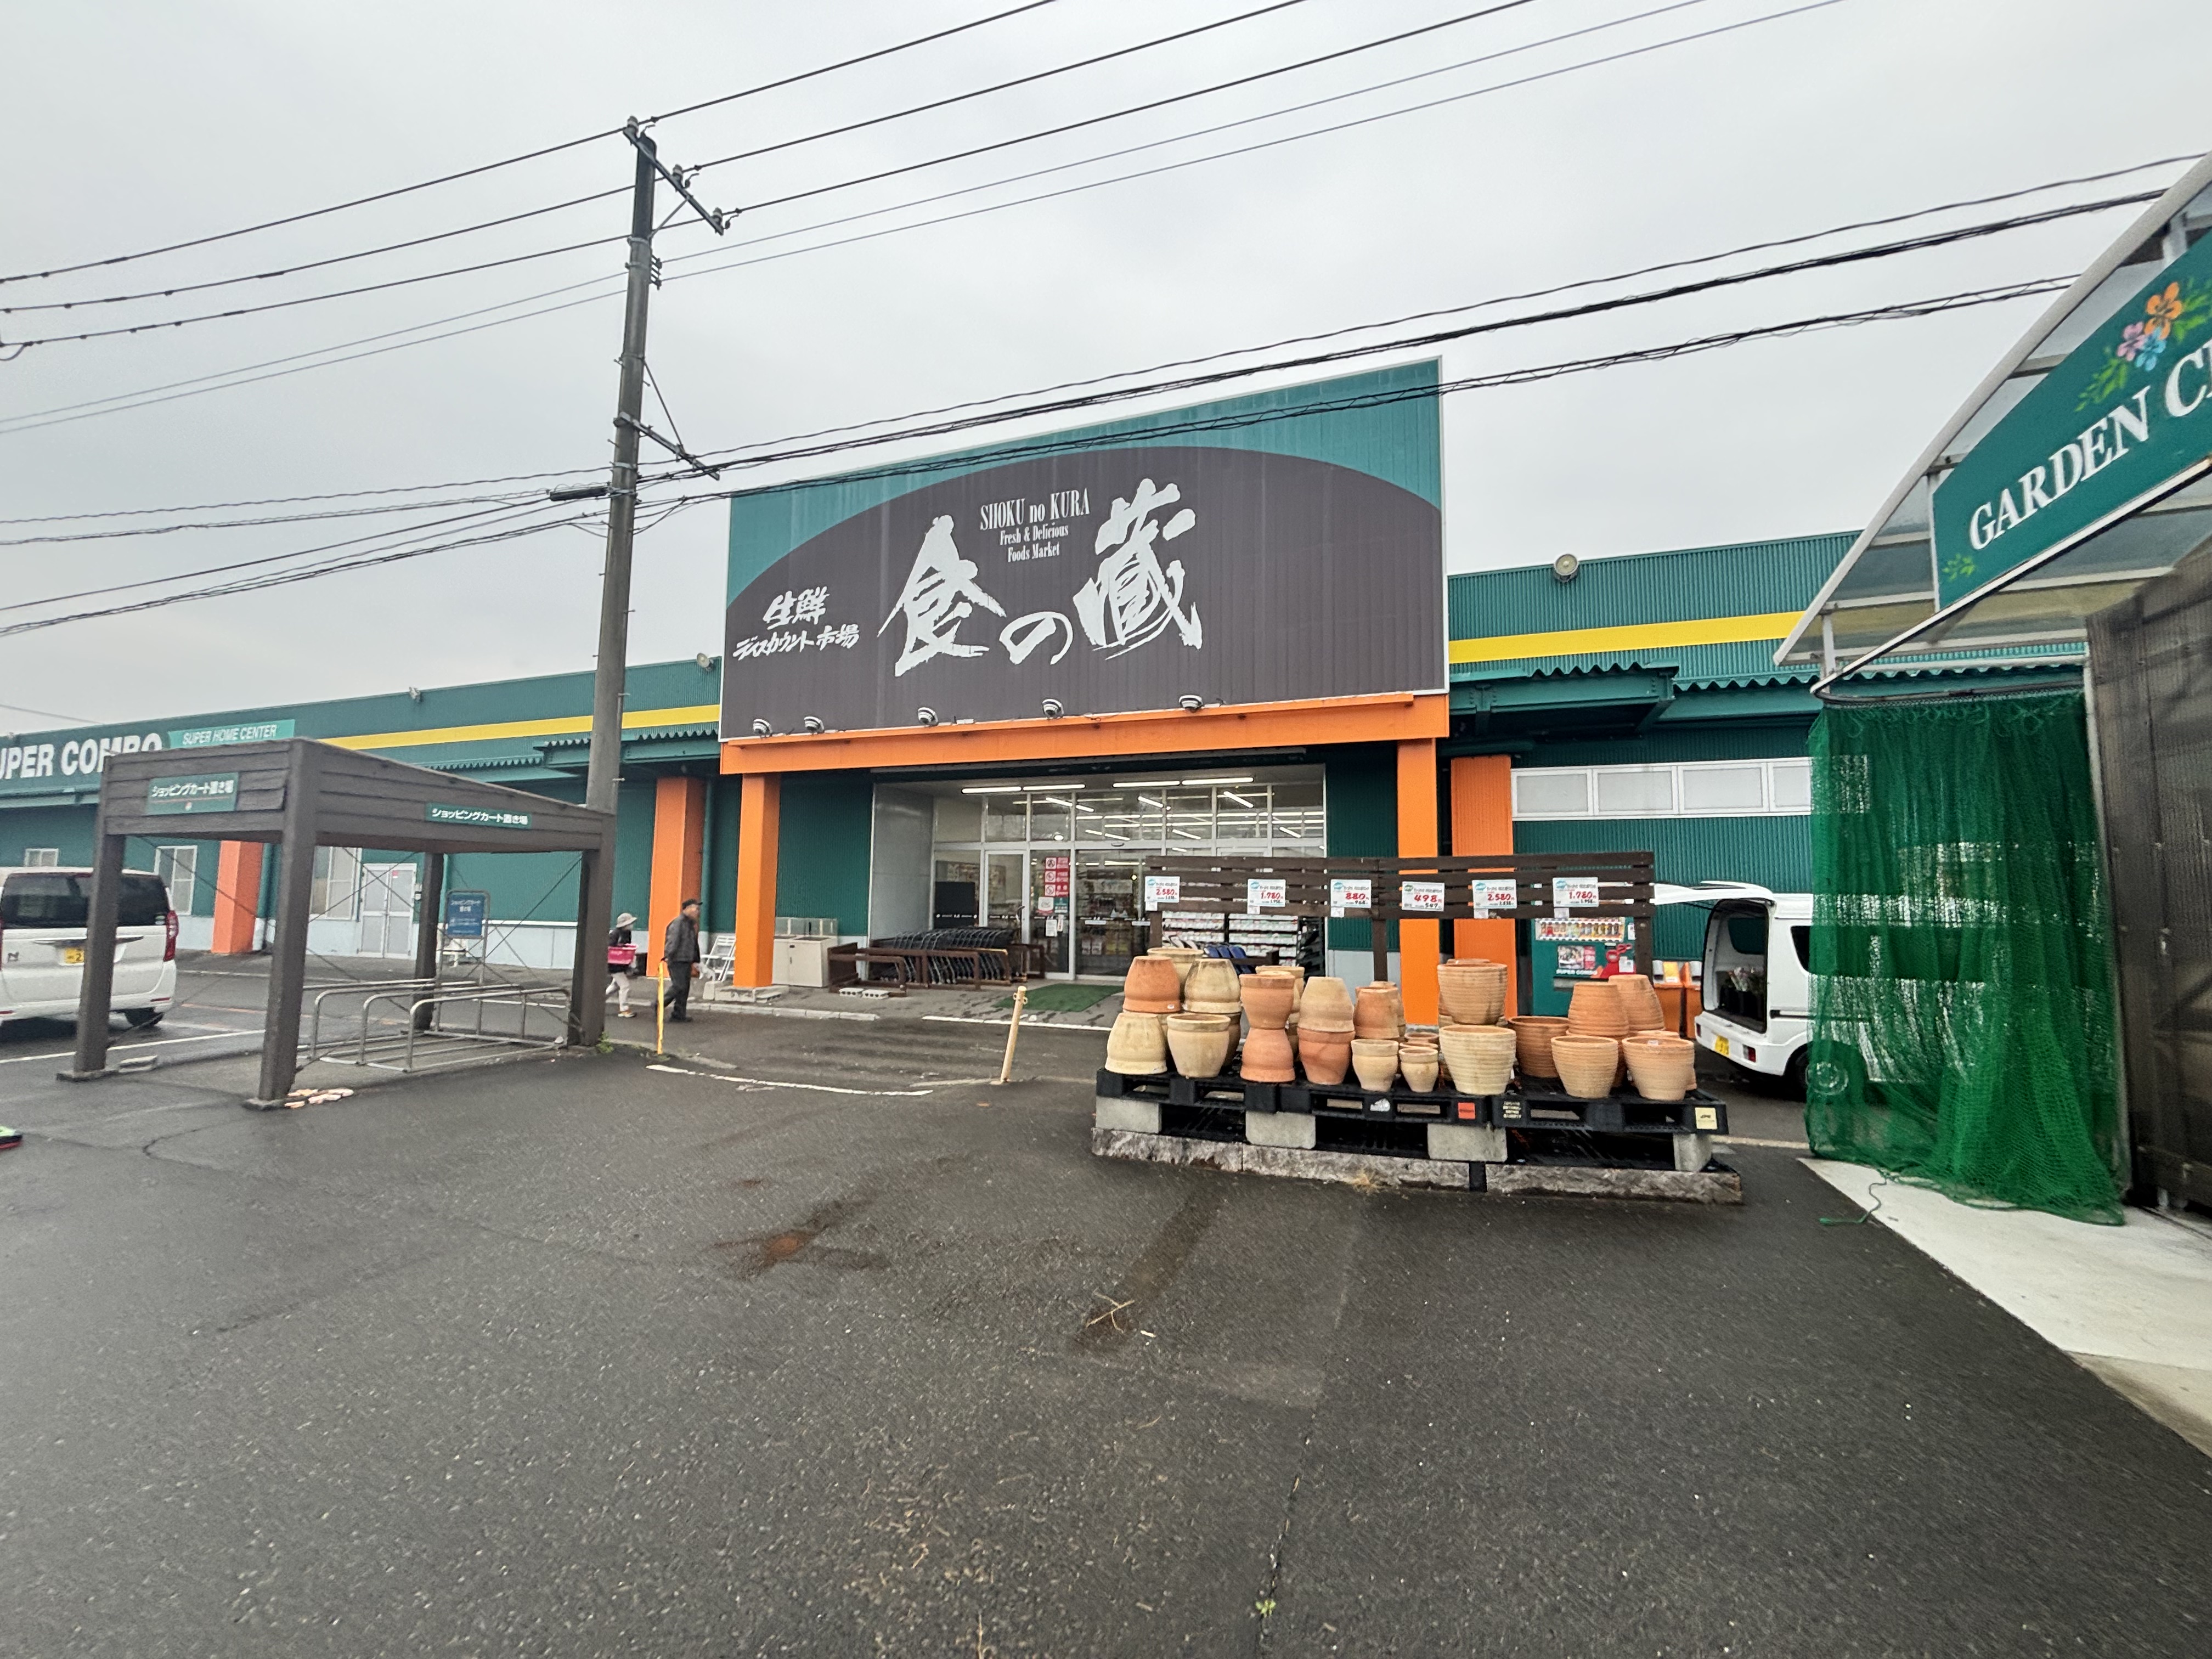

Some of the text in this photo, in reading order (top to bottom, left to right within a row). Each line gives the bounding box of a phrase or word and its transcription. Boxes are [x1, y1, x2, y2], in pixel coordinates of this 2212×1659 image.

[1969, 385, 2151, 550] GARDEN
[980, 487, 1090, 531] SHOKU no KURA
[1000, 522, 1069, 545] Fresh & Delicious
[1008, 541, 1060, 562] Foods Market
[878, 478, 1203, 677] 食の蔵
[763, 586, 830, 630] 生鮮
[183, 724, 277, 745] SUPER HOME CENTER
